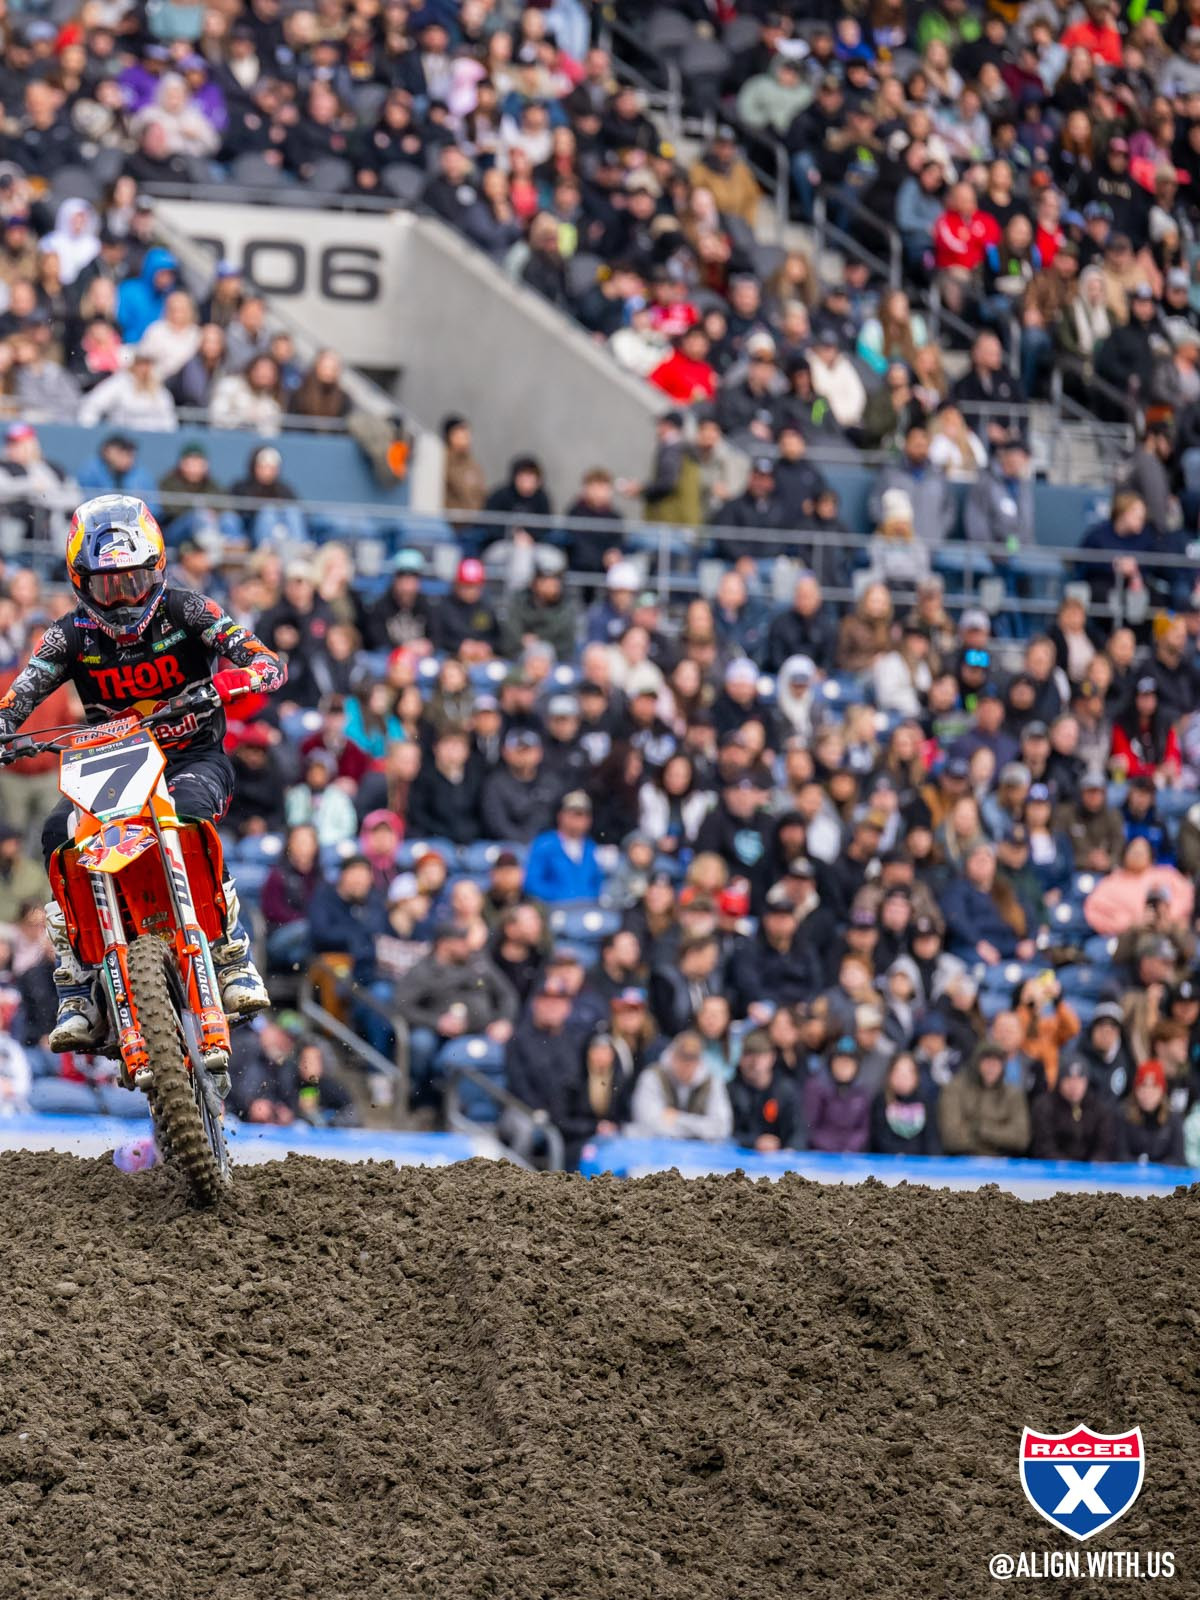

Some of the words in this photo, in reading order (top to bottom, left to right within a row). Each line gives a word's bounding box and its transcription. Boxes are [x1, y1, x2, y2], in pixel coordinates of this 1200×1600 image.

[88, 654, 186, 700] THOR
[154, 712, 199, 739] Bull
[80, 747, 150, 814] 7
[190, 933, 211, 996] DUNLP
[110, 967, 131, 1028] DUNOP
